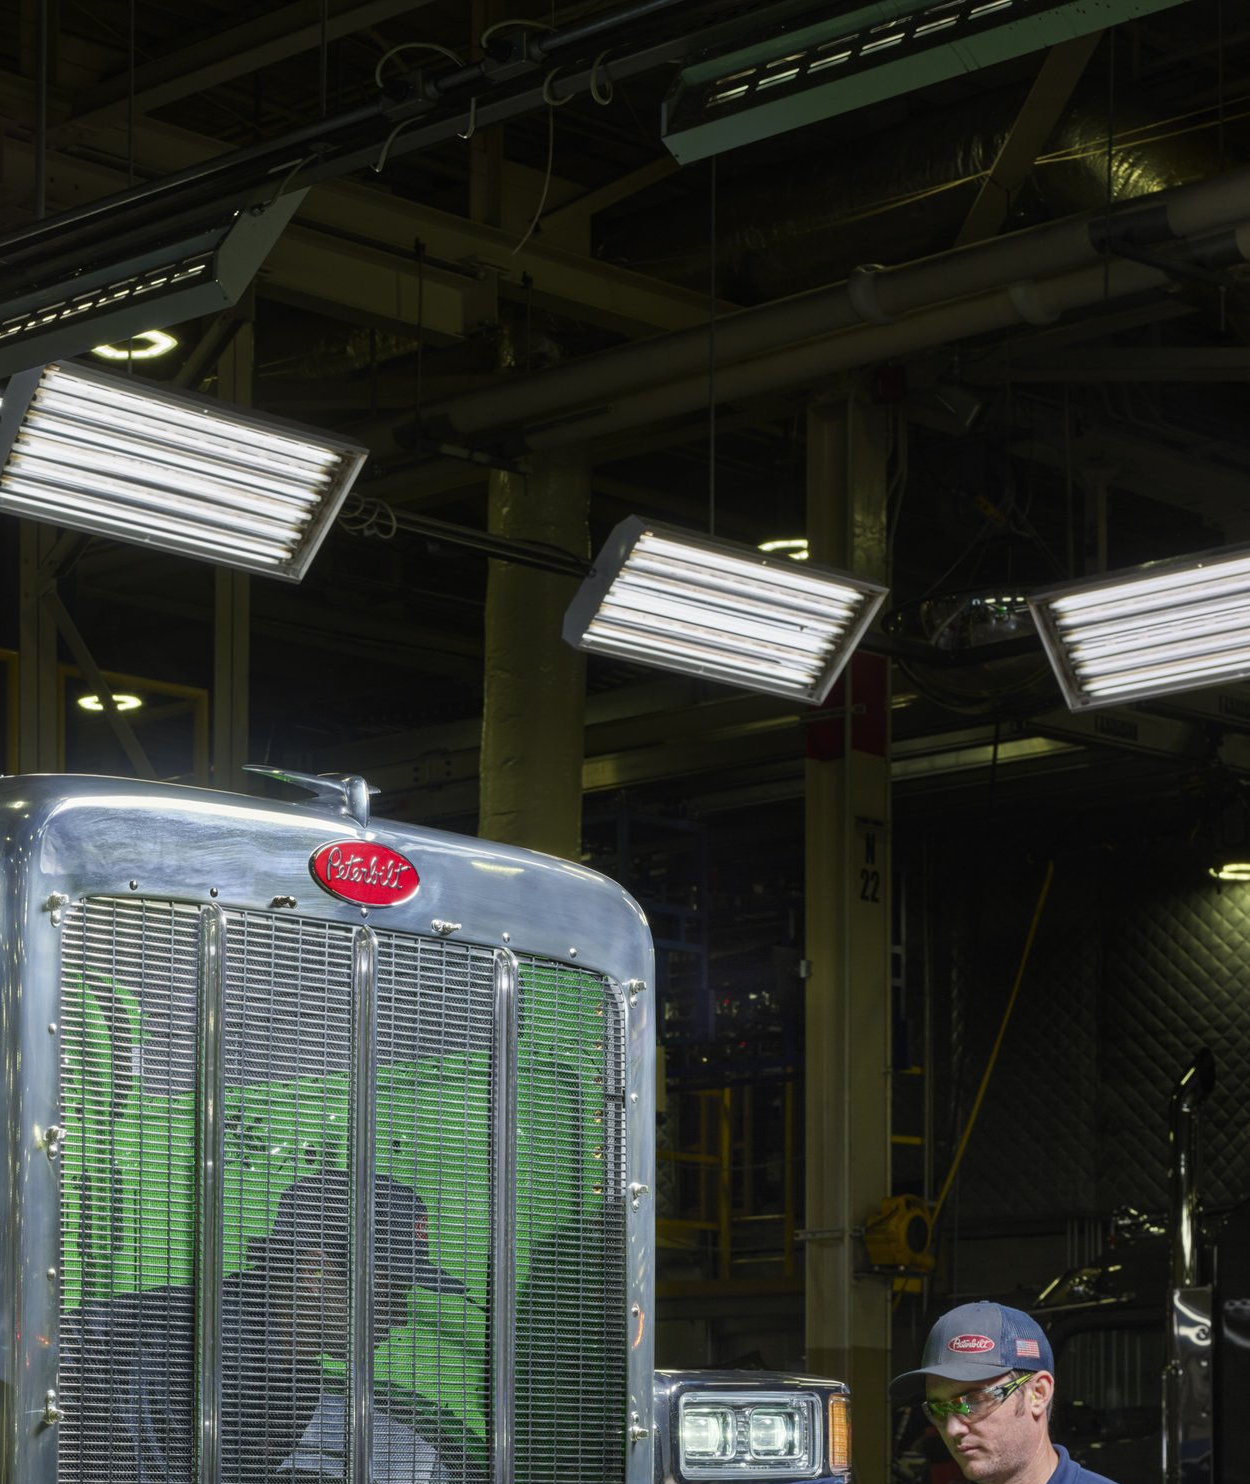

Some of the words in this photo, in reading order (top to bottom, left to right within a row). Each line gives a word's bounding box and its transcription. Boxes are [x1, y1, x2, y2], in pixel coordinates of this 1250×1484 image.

[865, 833, 876, 865] N
[326, 846, 411, 889] Peterbilt
[859, 868, 881, 903] 22
[952, 1336, 991, 1349] Peterbilt
